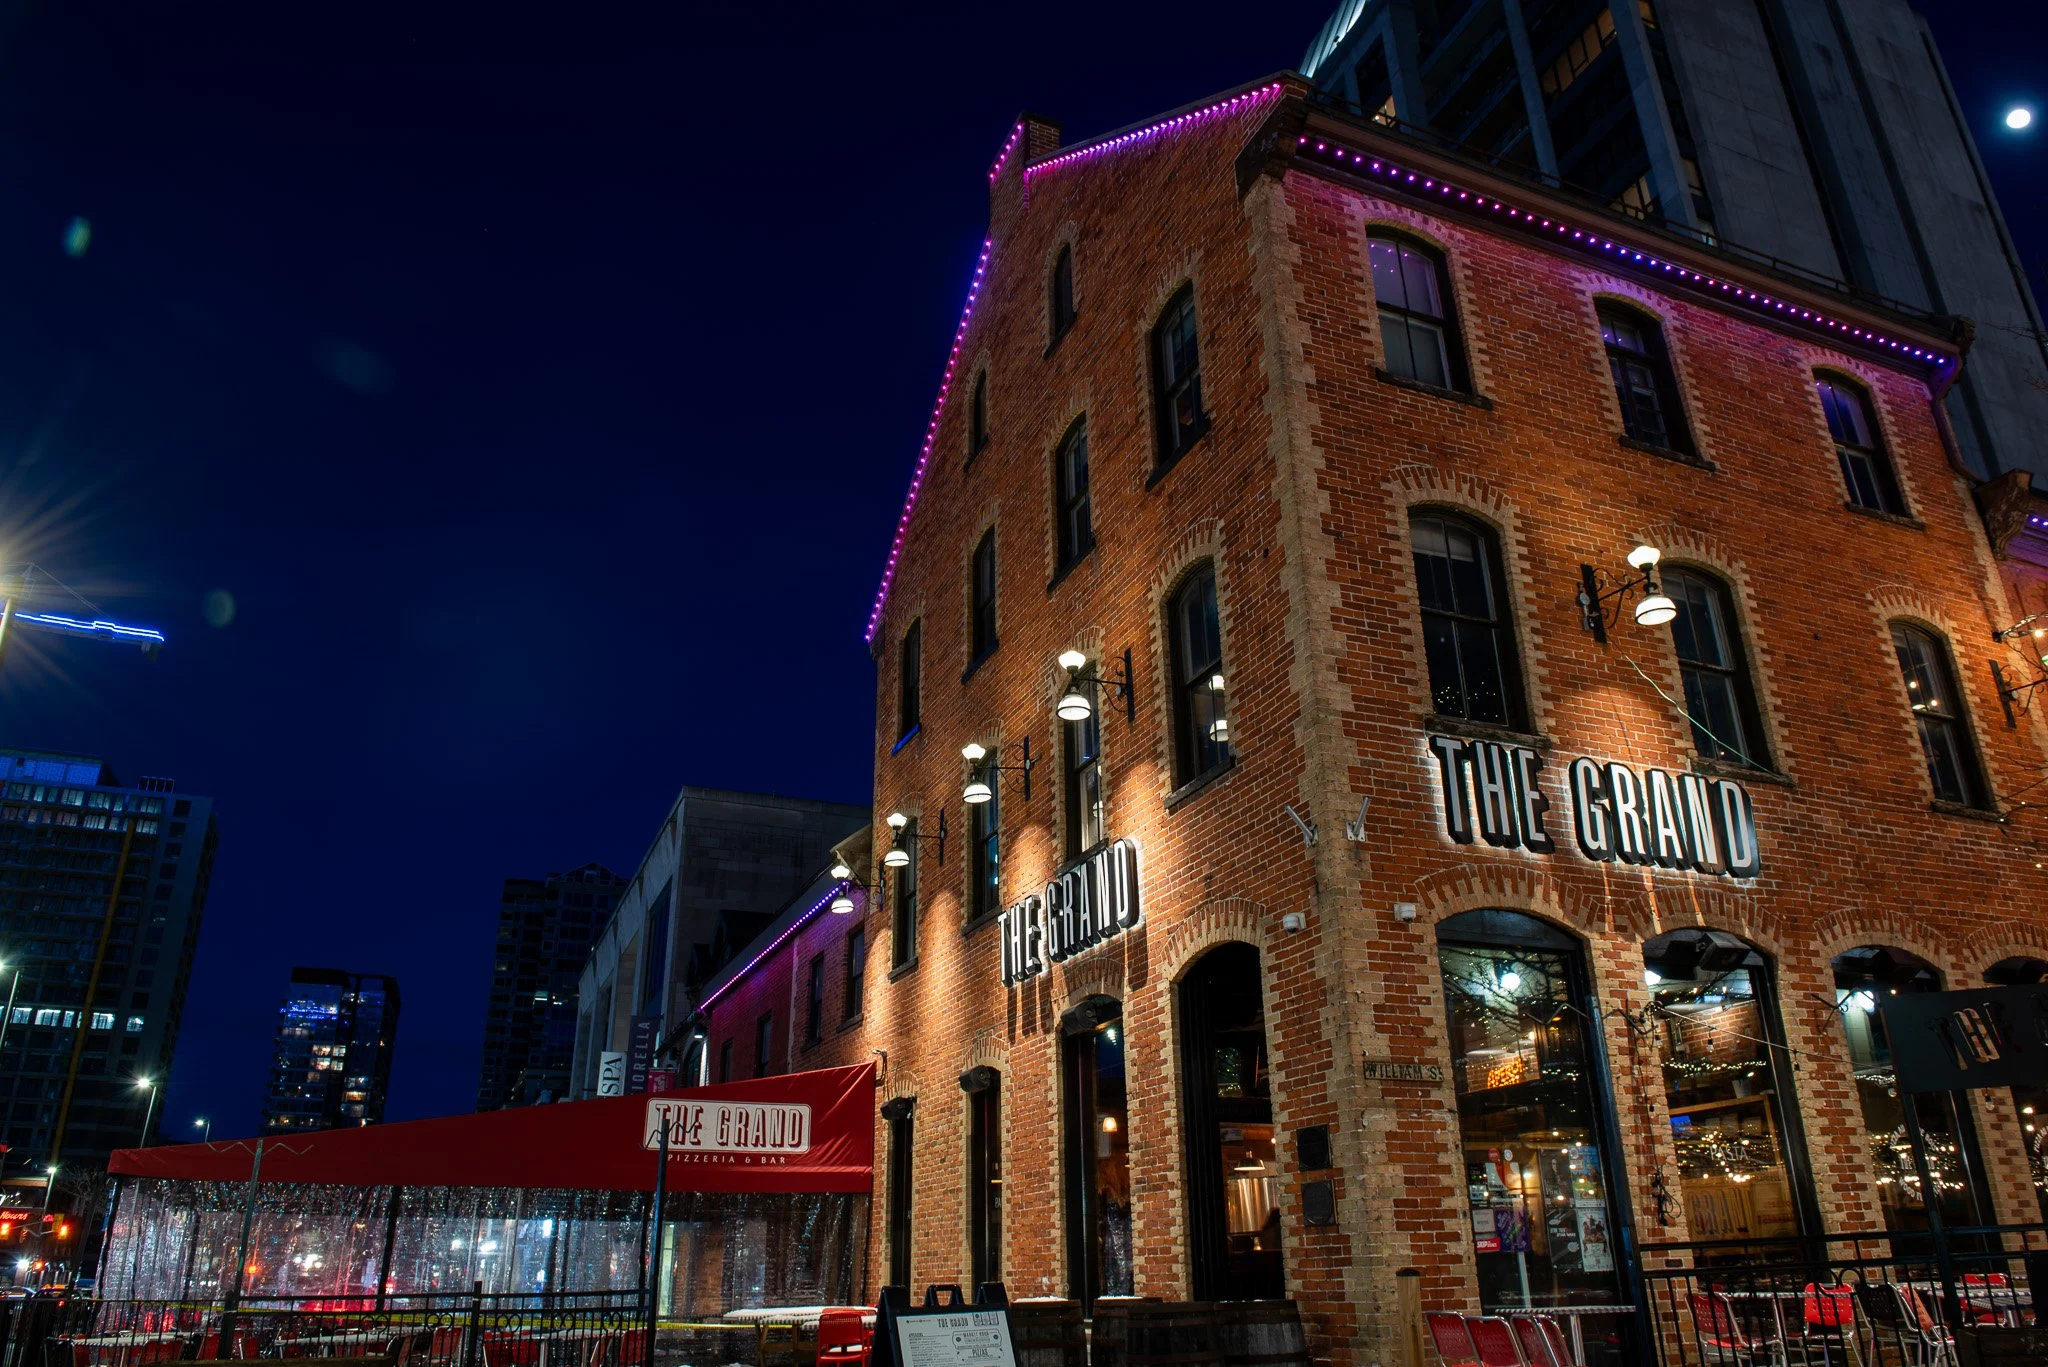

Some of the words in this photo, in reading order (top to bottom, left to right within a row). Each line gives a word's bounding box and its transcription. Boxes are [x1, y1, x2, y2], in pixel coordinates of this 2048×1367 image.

[1430, 735, 1555, 854] THE
[1569, 757, 1761, 878] GRAND
[997, 894, 1042, 987] THE
[1046, 838, 1139, 962] GRAND
[601, 1055, 623, 1095] SPA
[632, 1021, 651, 1090] IORELLA
[1366, 1063, 1423, 1080] WILLIAM
[655, 1103, 704, 1146] THE
[716, 1106, 804, 1148] GRAND
[667, 1154, 735, 1164] PIZZERIA
[744, 1156, 751, 1164] &
[761, 1156, 786, 1164] BAR
[1709, 1145, 1750, 1161] PASTA
